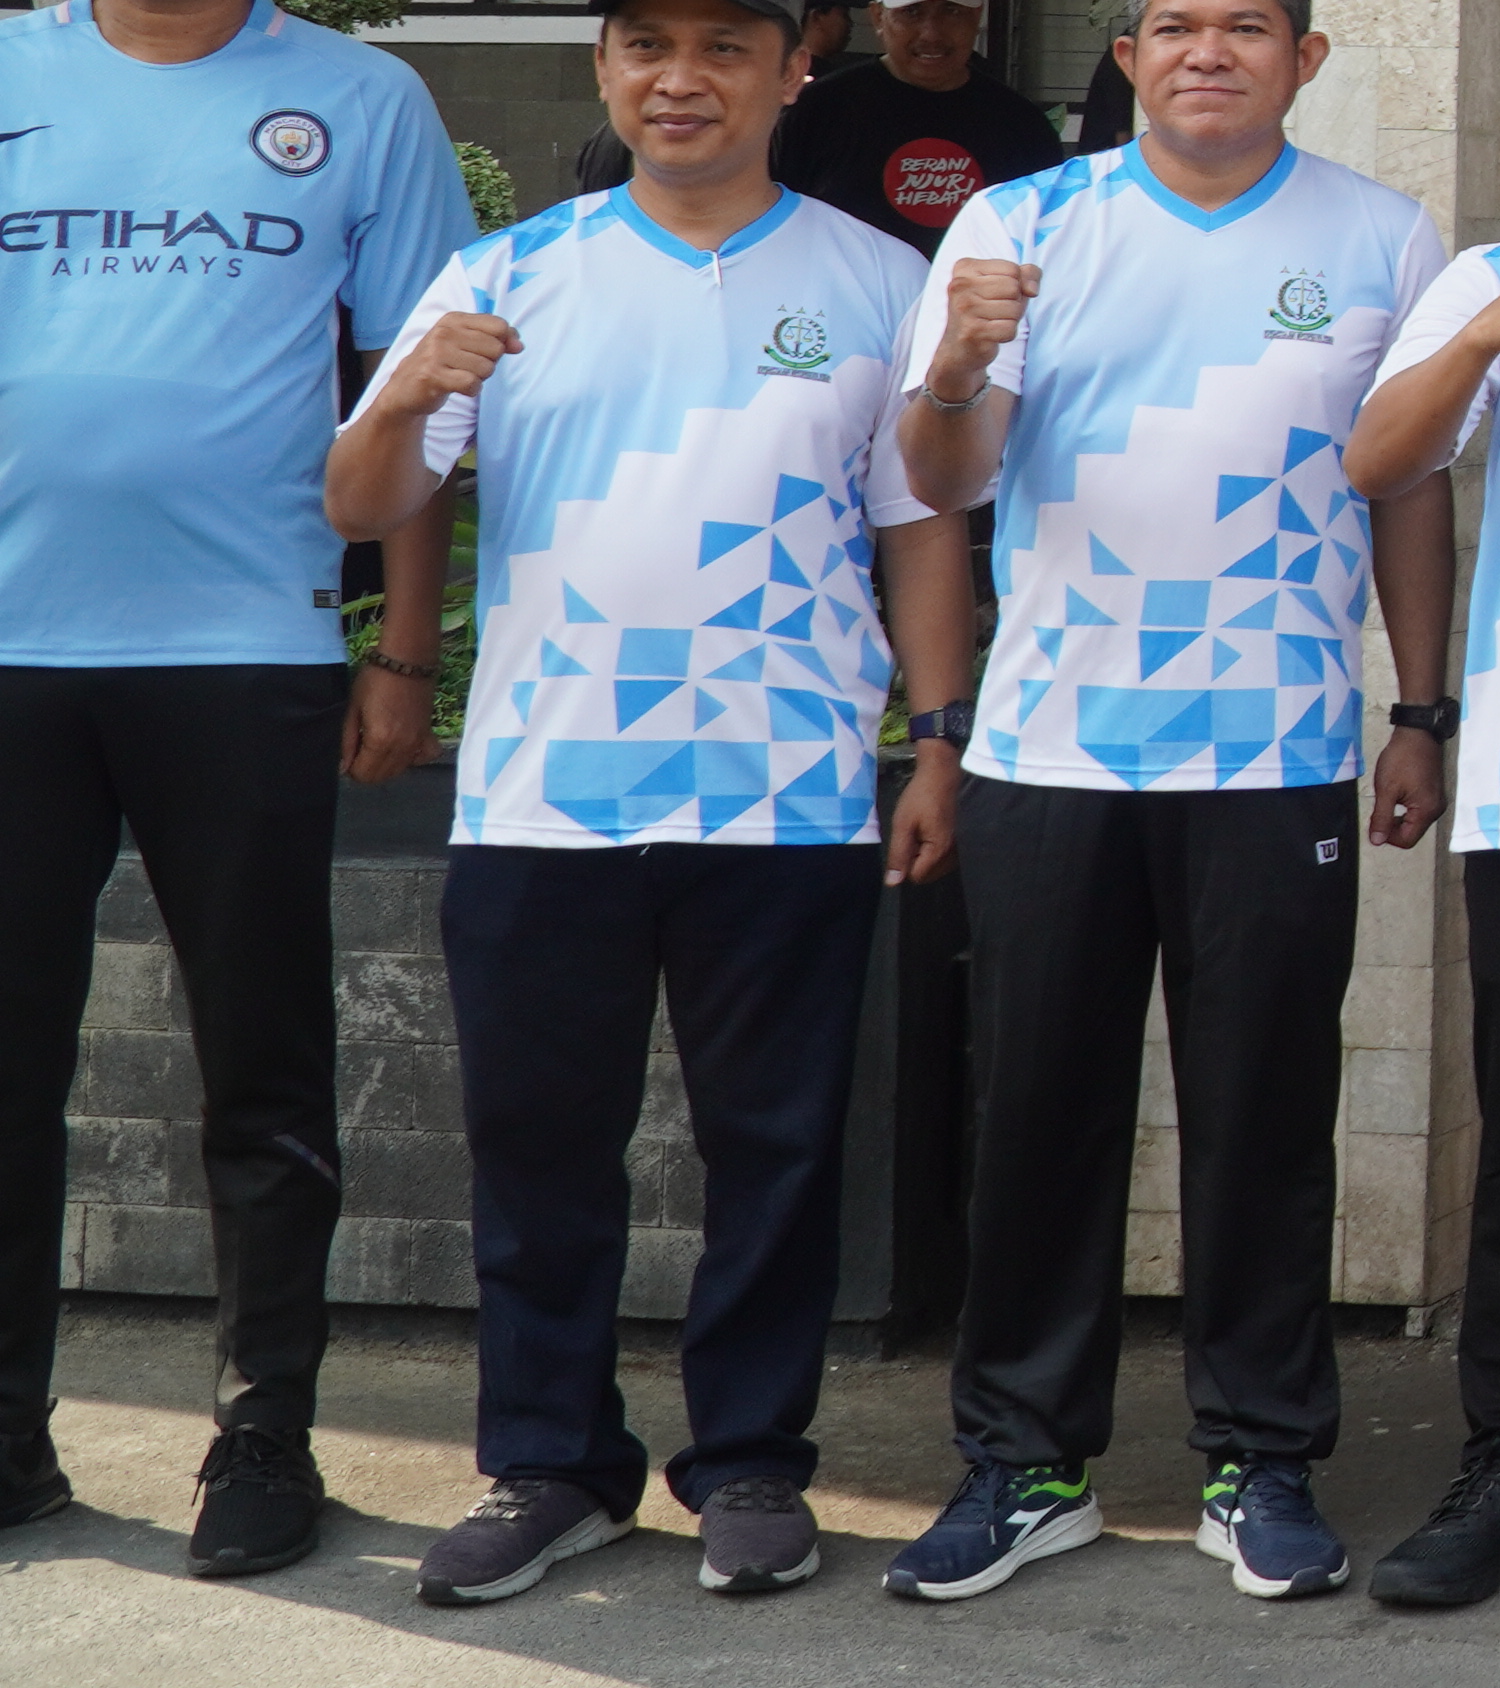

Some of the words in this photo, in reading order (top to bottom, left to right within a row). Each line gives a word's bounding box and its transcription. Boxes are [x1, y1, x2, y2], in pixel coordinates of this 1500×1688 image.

[281, 159, 302, 168] CITY
[901, 157, 971, 172] BERANI
[895, 173, 966, 191] JUJUR
[0, 209, 304, 257] ETIHAD
[52, 255, 243, 278] AIRWAYS
